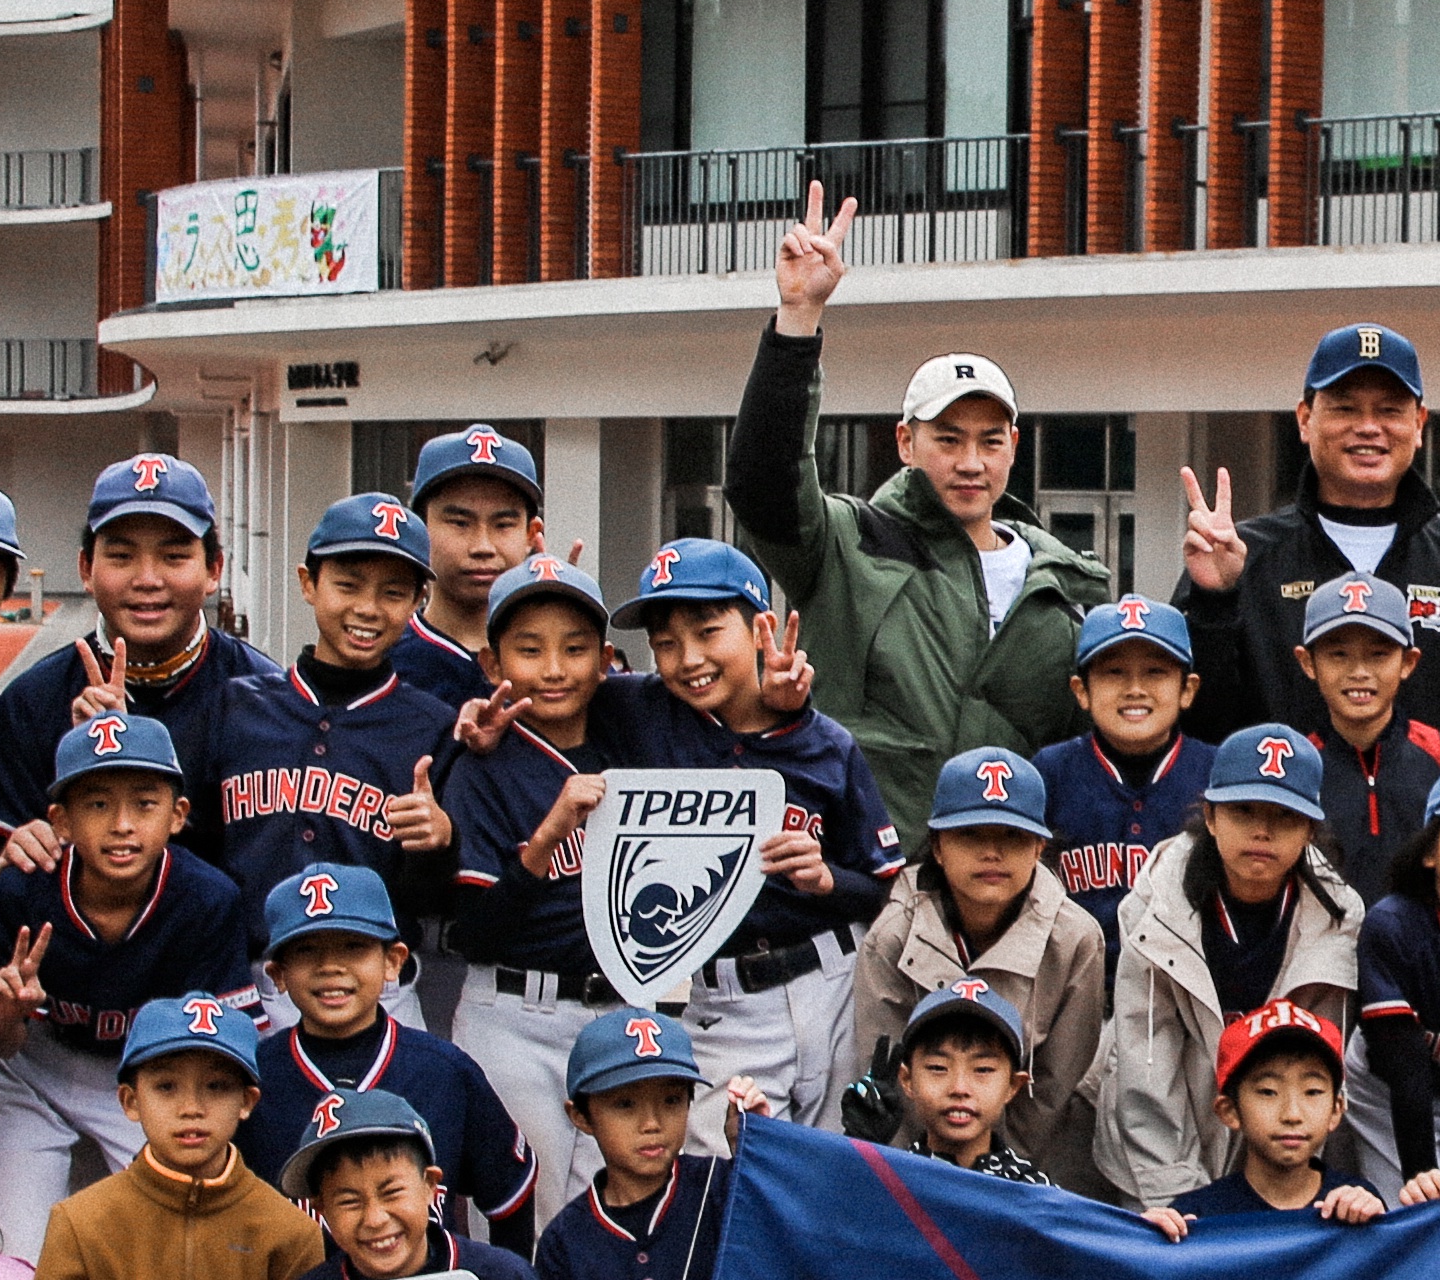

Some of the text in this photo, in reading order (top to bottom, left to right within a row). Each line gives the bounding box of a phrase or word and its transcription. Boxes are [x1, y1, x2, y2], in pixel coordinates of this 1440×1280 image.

[955, 364, 976, 380] R
[465, 429, 502, 464] T
[133, 455, 168, 492] T
[371, 501, 408, 540] T
[528, 556, 563, 582] T
[649, 547, 681, 587] T
[1115, 599, 1151, 630] T
[1339, 580, 1373, 613] T
[87, 715, 127, 756] T
[1256, 736, 1295, 778] T
[975, 761, 1013, 802] T
[618, 789, 757, 827] TPBPA
[299, 873, 338, 916] T
[951, 977, 990, 1003] T
[182, 998, 224, 1036] T
[1244, 1001, 1323, 1038] TJS
[623, 1015, 663, 1058] T
[311, 1093, 345, 1139] T
